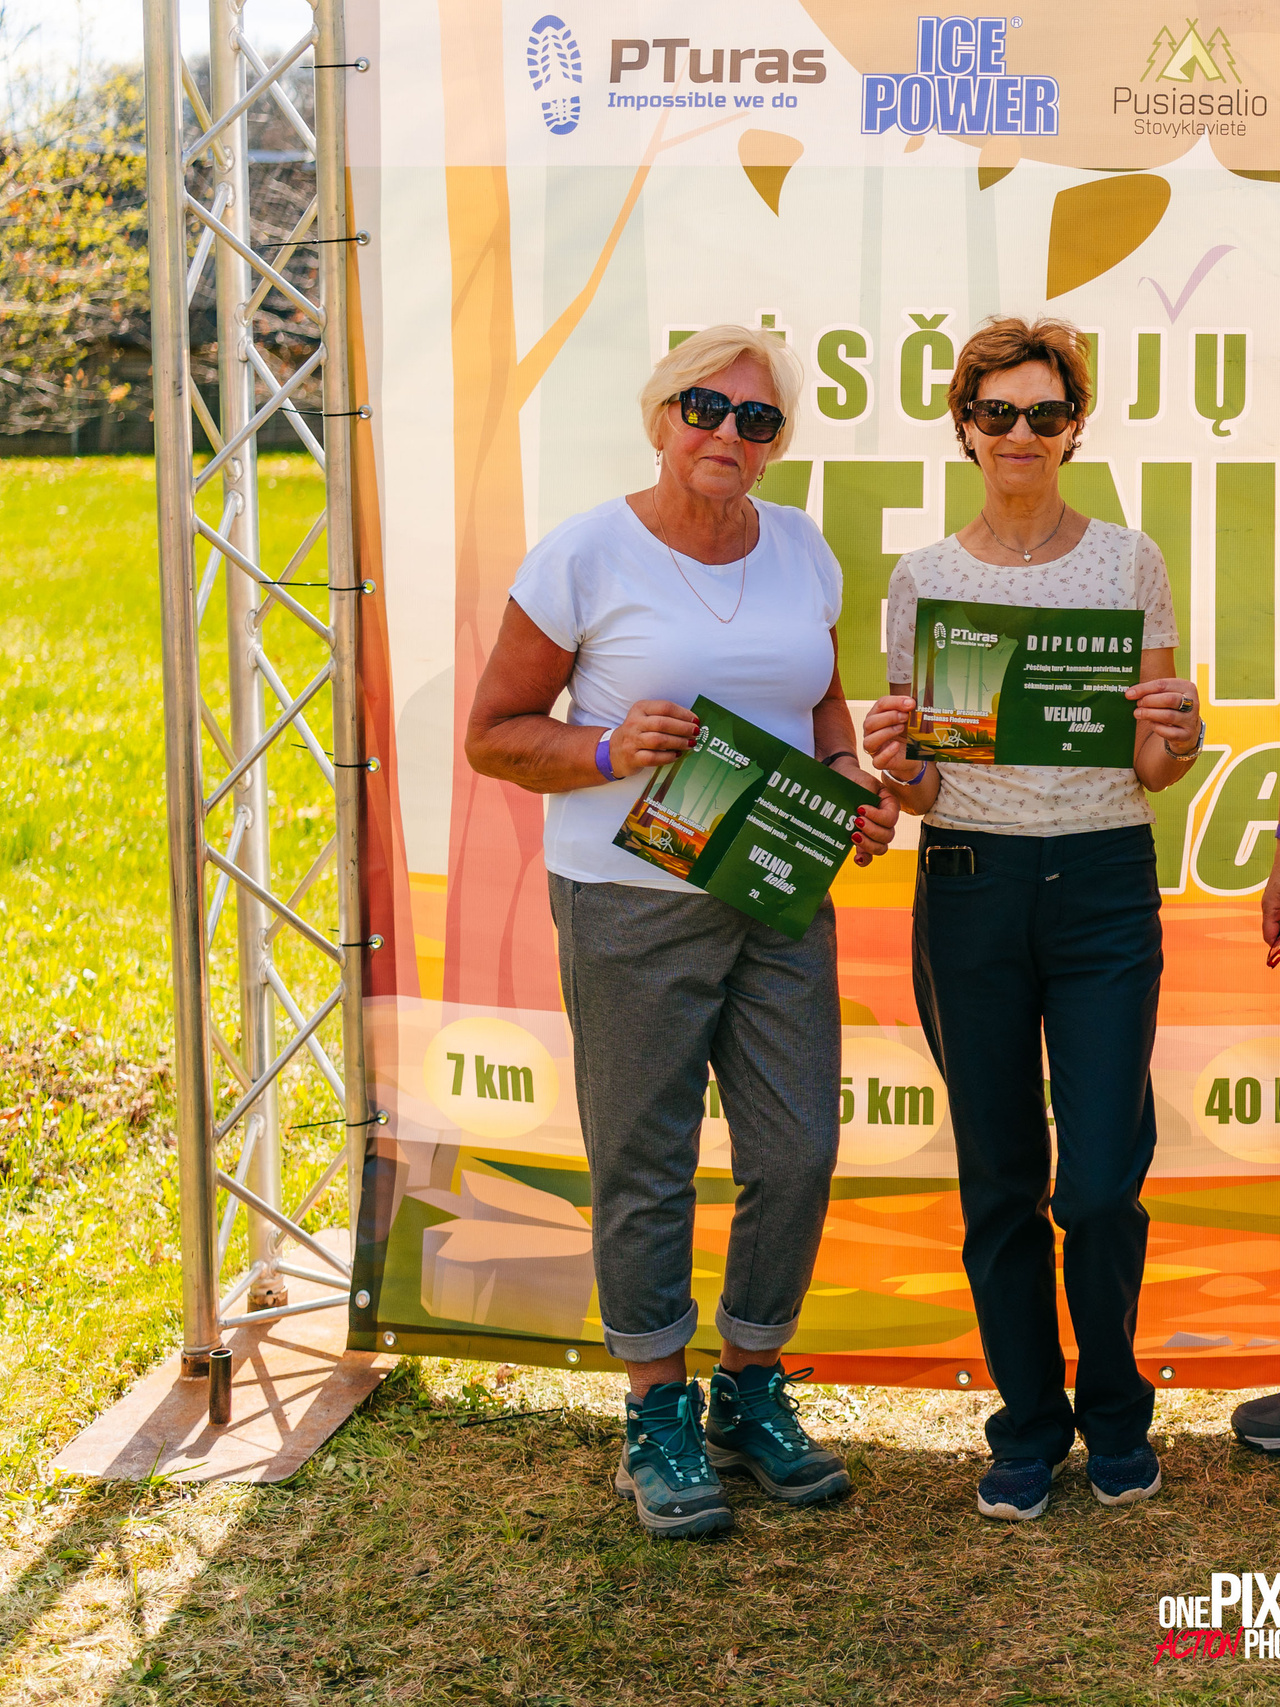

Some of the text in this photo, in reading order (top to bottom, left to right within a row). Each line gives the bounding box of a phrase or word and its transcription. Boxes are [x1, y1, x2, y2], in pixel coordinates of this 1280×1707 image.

[610, 38, 827, 84] PTuras
[916, 16, 1007, 76] ICE
[608, 92, 798, 111] Impossible we do
[861, 74, 1059, 136] POWER
[1113, 87, 1268, 116] Pusiasalio
[1134, 118, 1247, 138] Stovyklavietė
[950, 628, 999, 643] PTuras
[1027, 634, 1133, 654] DIPLOMAS
[1044, 706, 1092, 722] VELNIO
[1068, 721, 1105, 733] keliais
[709, 736, 751, 767] PTuras
[767, 770, 857, 832] DIPLOMAS
[748, 844, 793, 879] VELNIO
[763, 872, 797, 895] keliais
[446, 1052, 534, 1103] 7 km
[868, 1077, 934, 1125] km
[1205, 1077, 1262, 1124] 40
